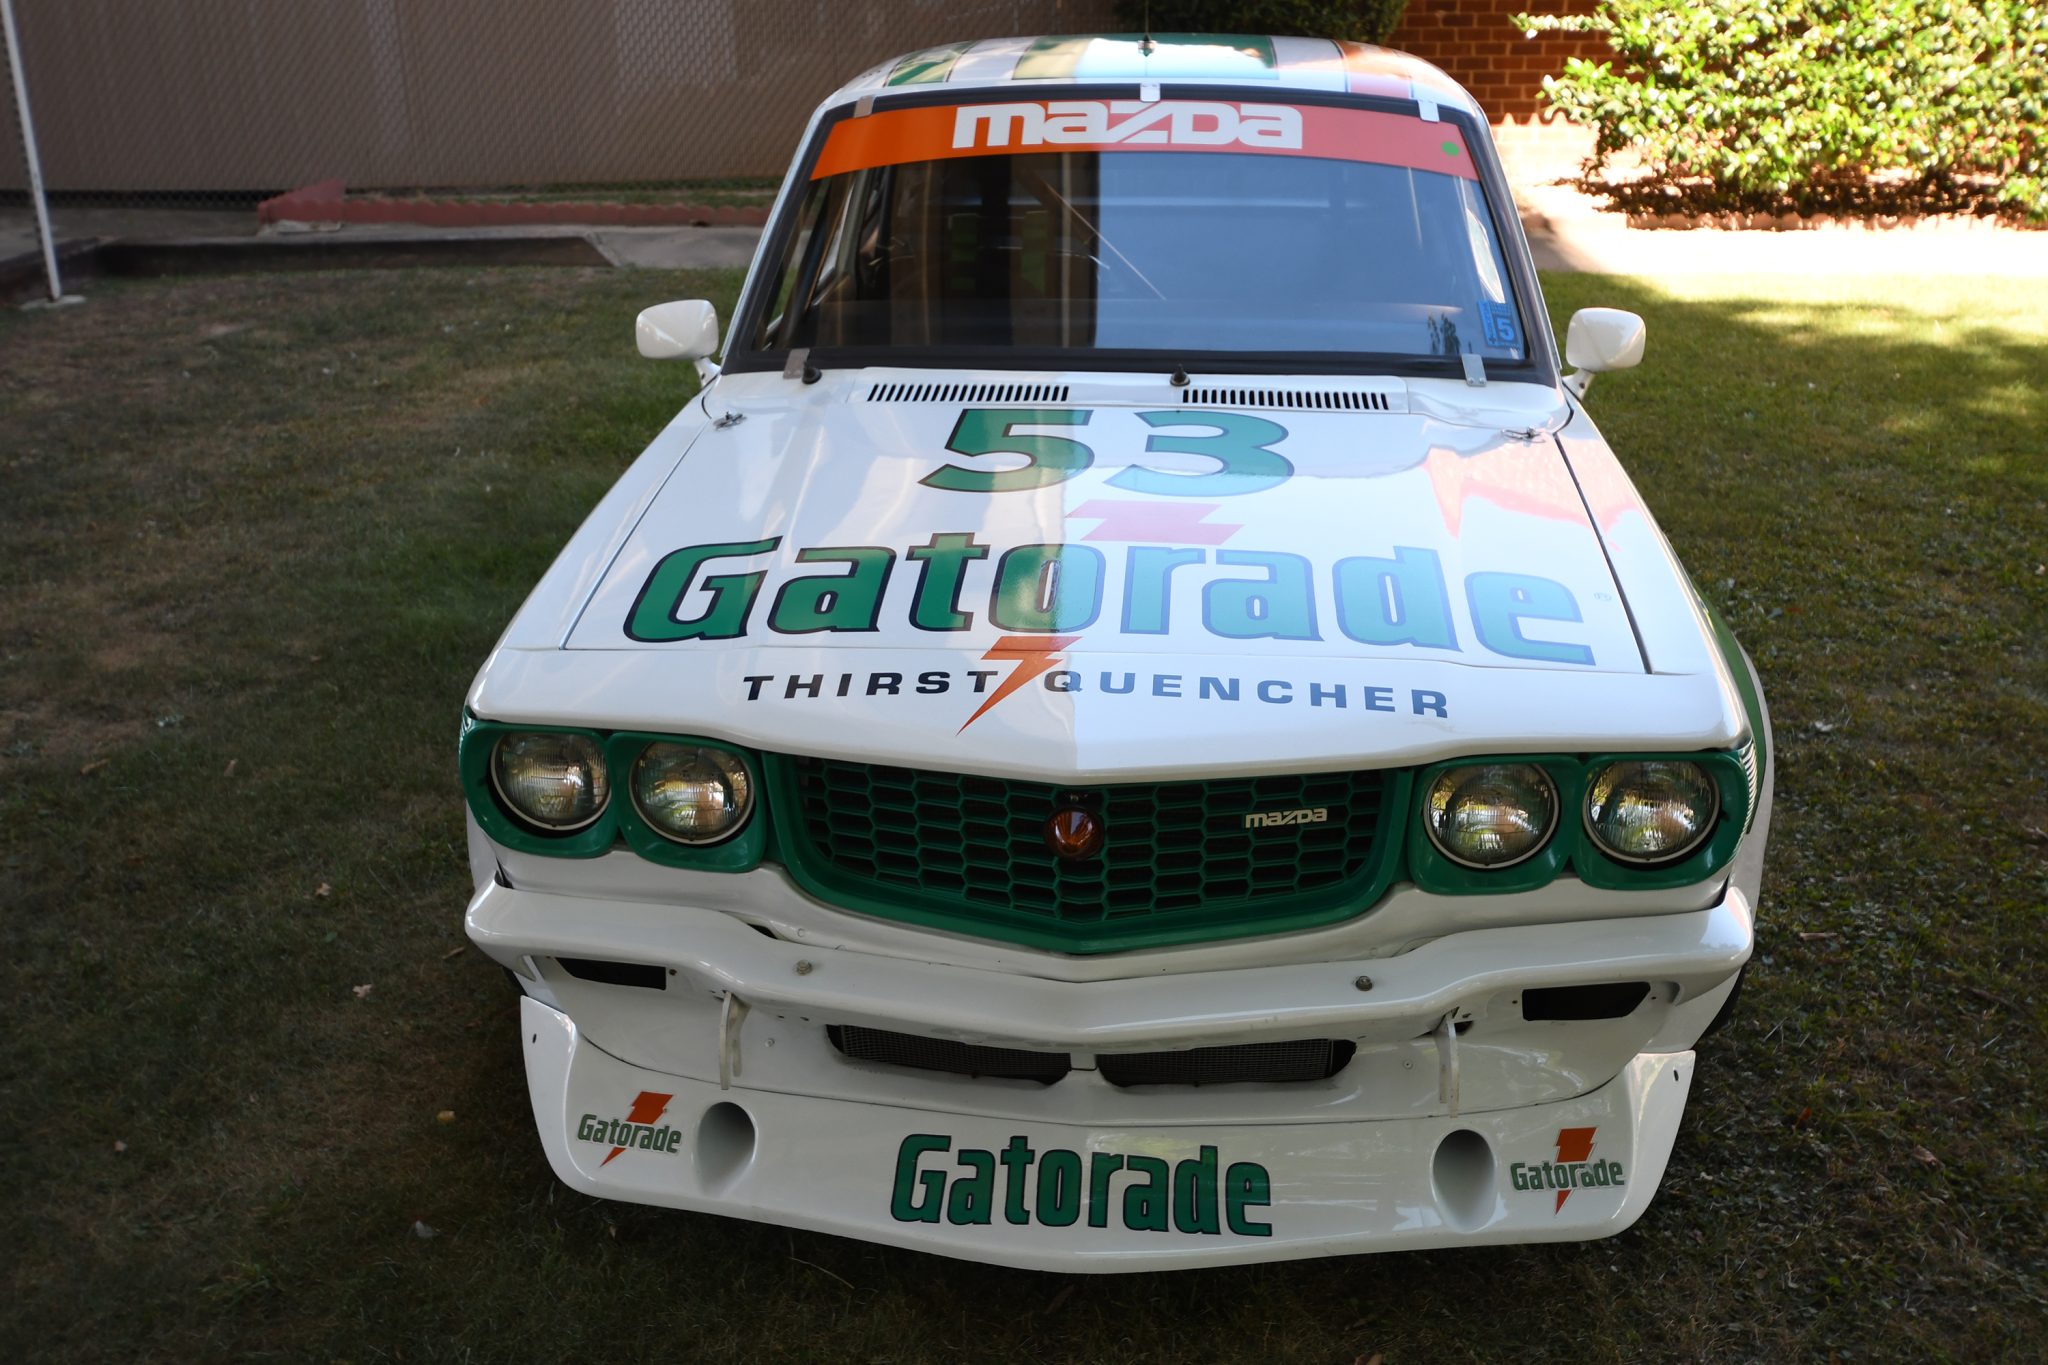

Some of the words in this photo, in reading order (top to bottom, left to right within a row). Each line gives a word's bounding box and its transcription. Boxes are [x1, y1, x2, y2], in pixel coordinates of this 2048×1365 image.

[952, 100, 1303, 149] mazda
[917, 408, 1296, 498] 53
[622, 531, 1596, 667] Gatorade
[743, 670, 999, 701] THIRST
[1043, 670, 1449, 719] QUENCHER
[1245, 807, 1328, 829] mazda
[577, 1113, 682, 1154] Gatorade
[890, 1133, 1273, 1237] Gatorade
[1510, 1158, 1625, 1191] Gatorade
